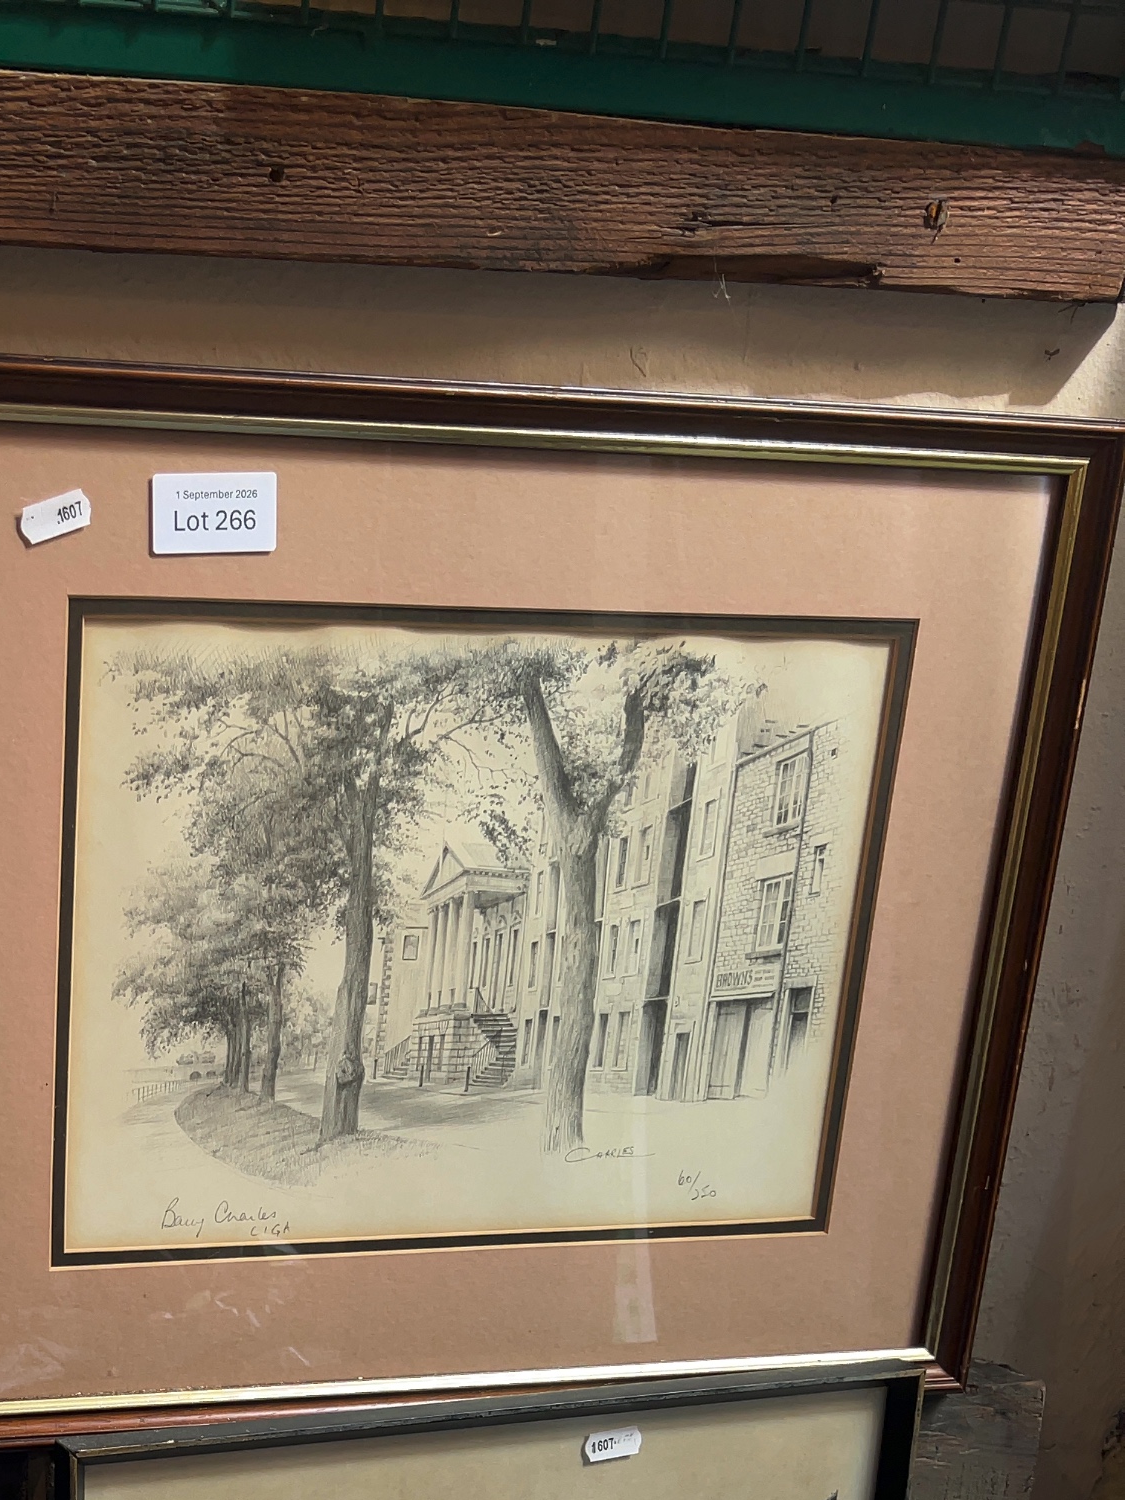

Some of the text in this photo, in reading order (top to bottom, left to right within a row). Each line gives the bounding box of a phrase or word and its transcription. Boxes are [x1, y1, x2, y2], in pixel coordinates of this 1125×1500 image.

[182, 490, 234, 501] September
[235, 489, 258, 499] 2026
[174, 509, 256, 532] Lot 266
[214, 1200, 277, 1224] Charles
[591, 1437, 615, 1453] 1607
